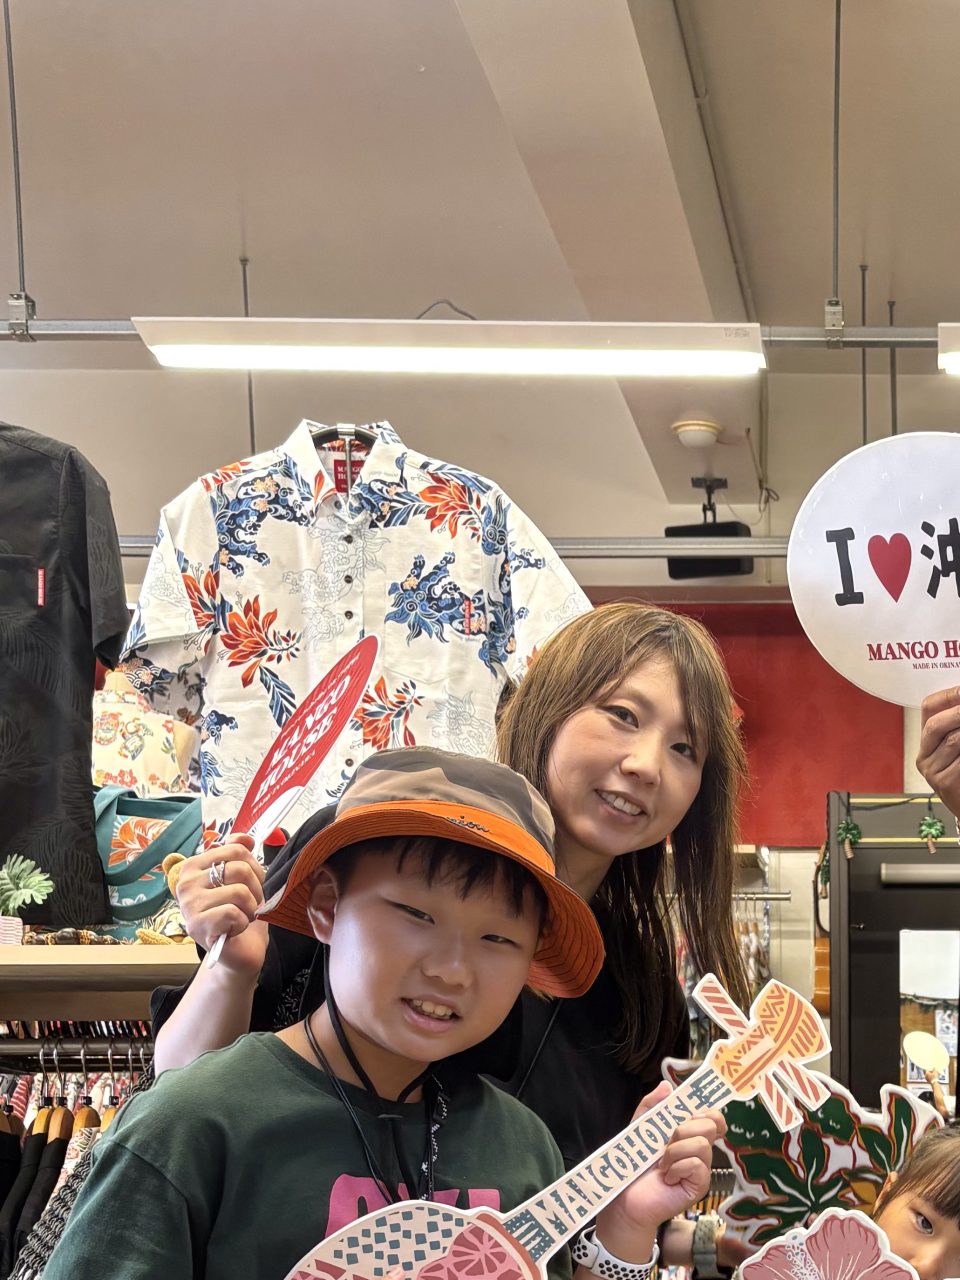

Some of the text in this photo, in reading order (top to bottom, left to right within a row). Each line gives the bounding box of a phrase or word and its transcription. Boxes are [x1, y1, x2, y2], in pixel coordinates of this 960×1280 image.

[825, 527, 865, 606] I
[866, 640, 939, 661] MANGO
[912, 662, 930, 670] MADE
